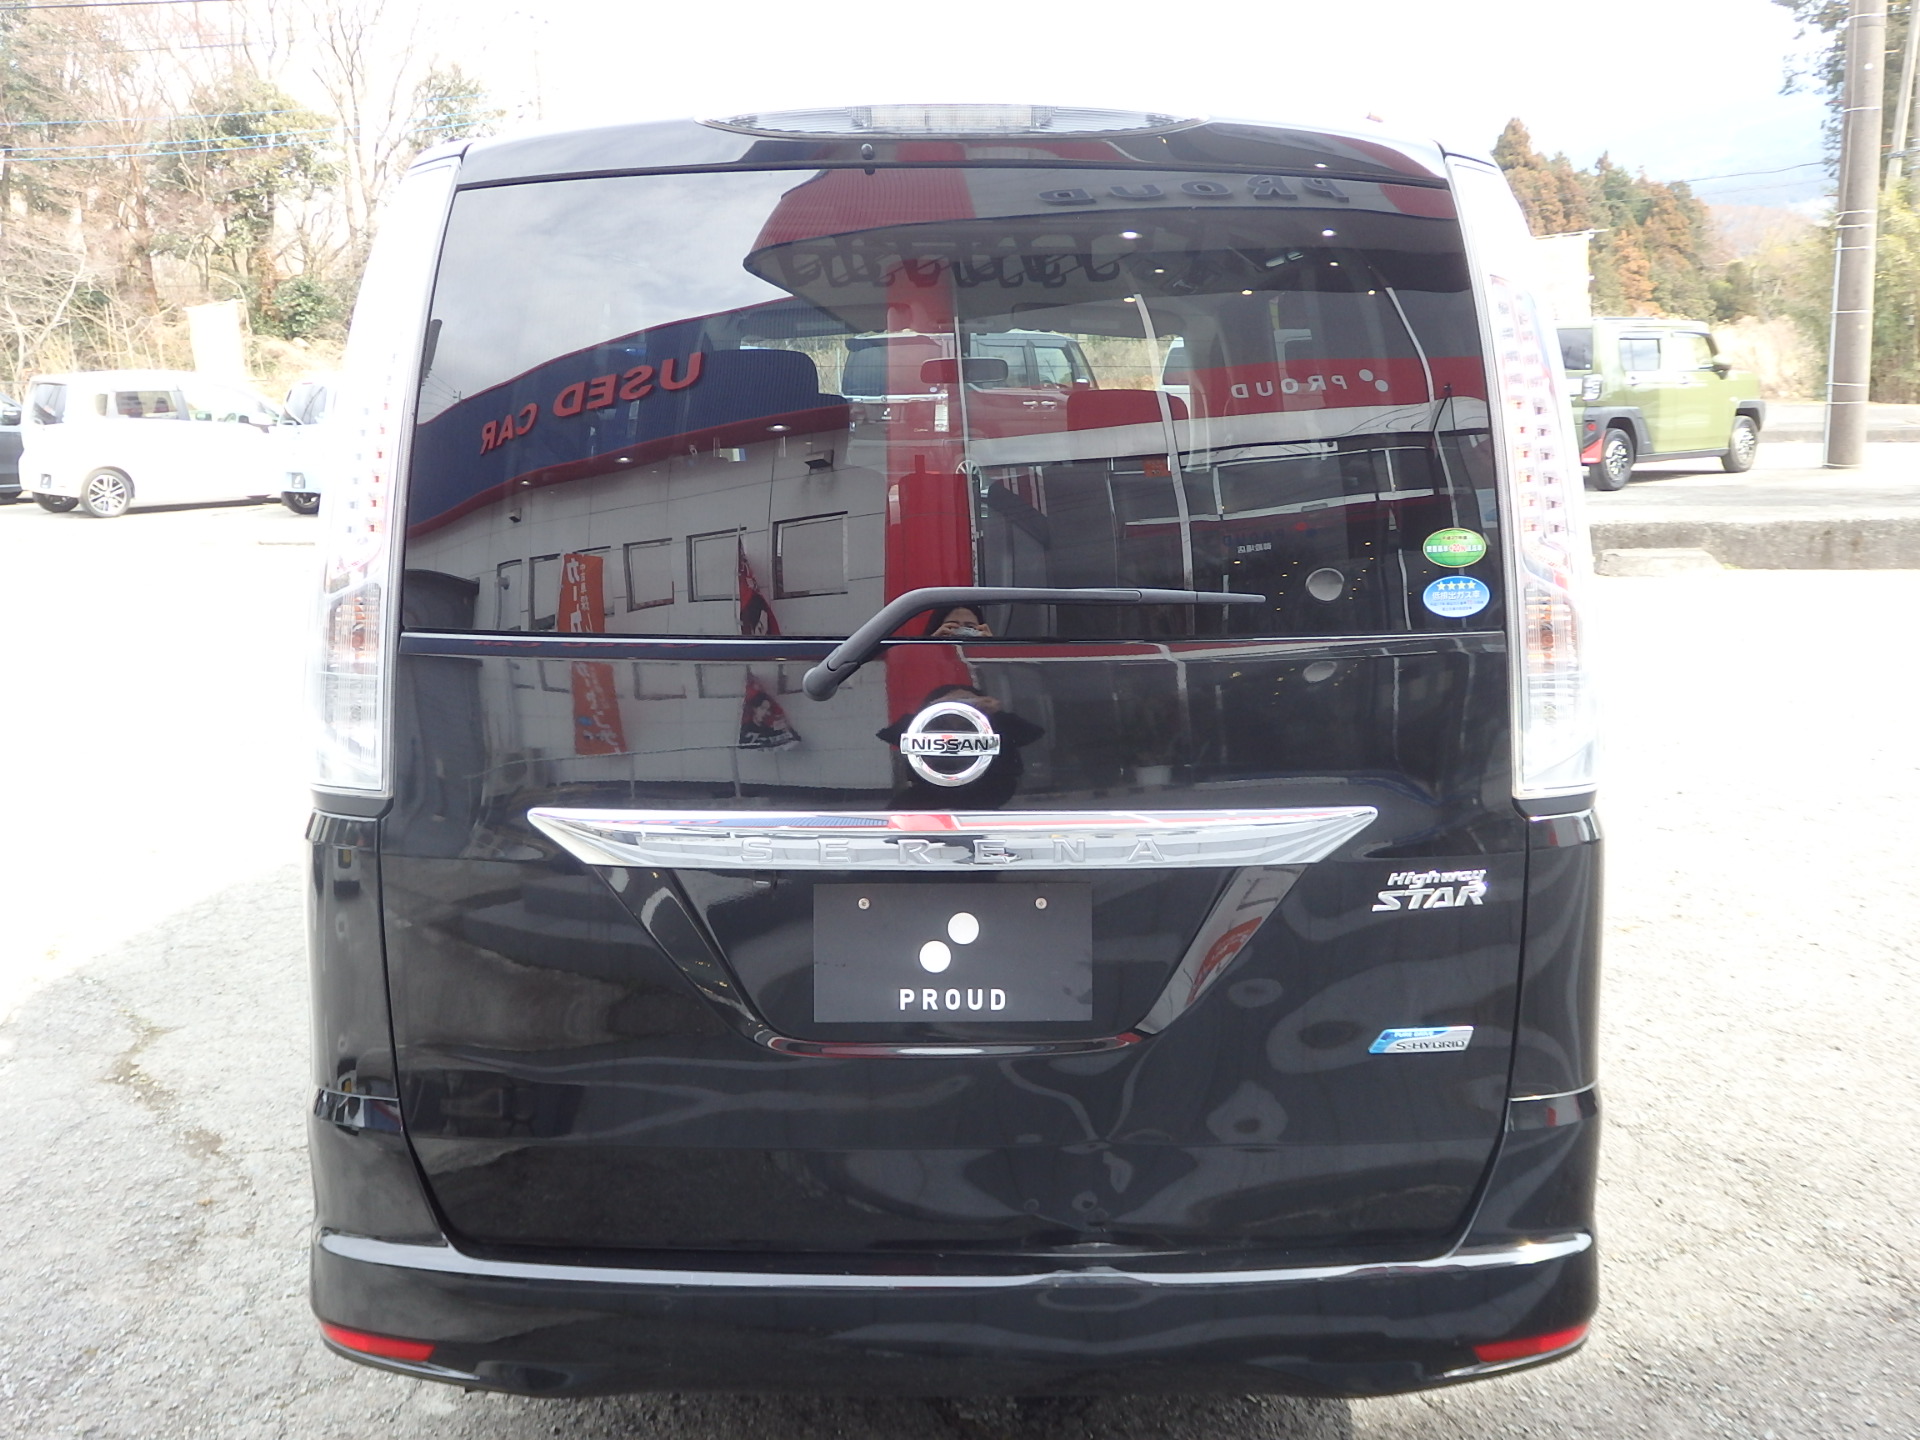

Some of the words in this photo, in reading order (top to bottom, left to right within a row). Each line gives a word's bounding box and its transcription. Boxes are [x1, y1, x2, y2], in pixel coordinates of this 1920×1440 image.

[911, 738, 989, 751] NISSAN
[741, 837, 1165, 865] SERENA
[1387, 869, 1487, 889] Highway
[1371, 885, 1487, 912] STAR
[899, 988, 1006, 1011] PROUD
